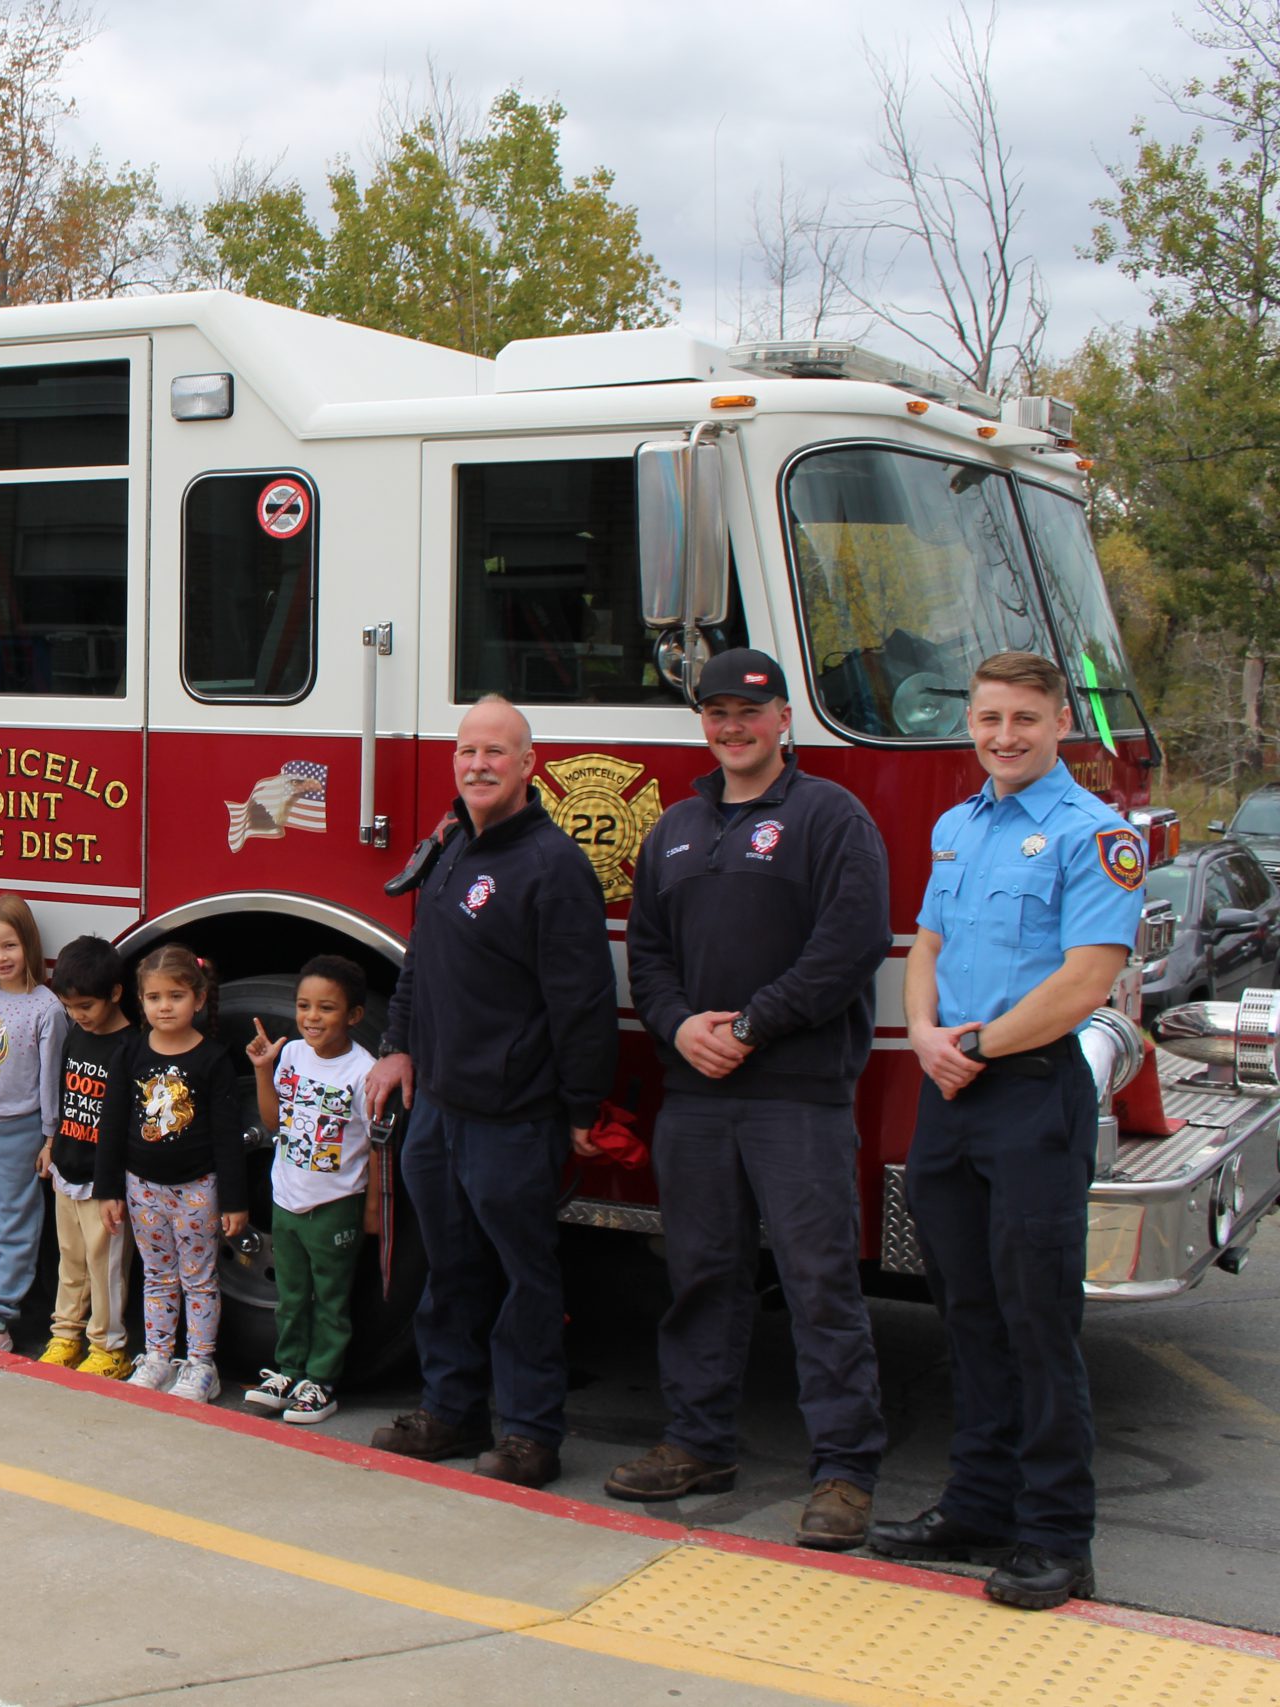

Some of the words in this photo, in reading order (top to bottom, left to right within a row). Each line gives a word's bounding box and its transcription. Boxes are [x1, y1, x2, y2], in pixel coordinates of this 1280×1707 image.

[565, 767, 624, 785] MONTICELLO
[570, 813, 616, 845] 22
[20, 830, 102, 863] DIST.
[77, 1094, 103, 1114] TAKE
[79, 1111, 101, 1128] my
